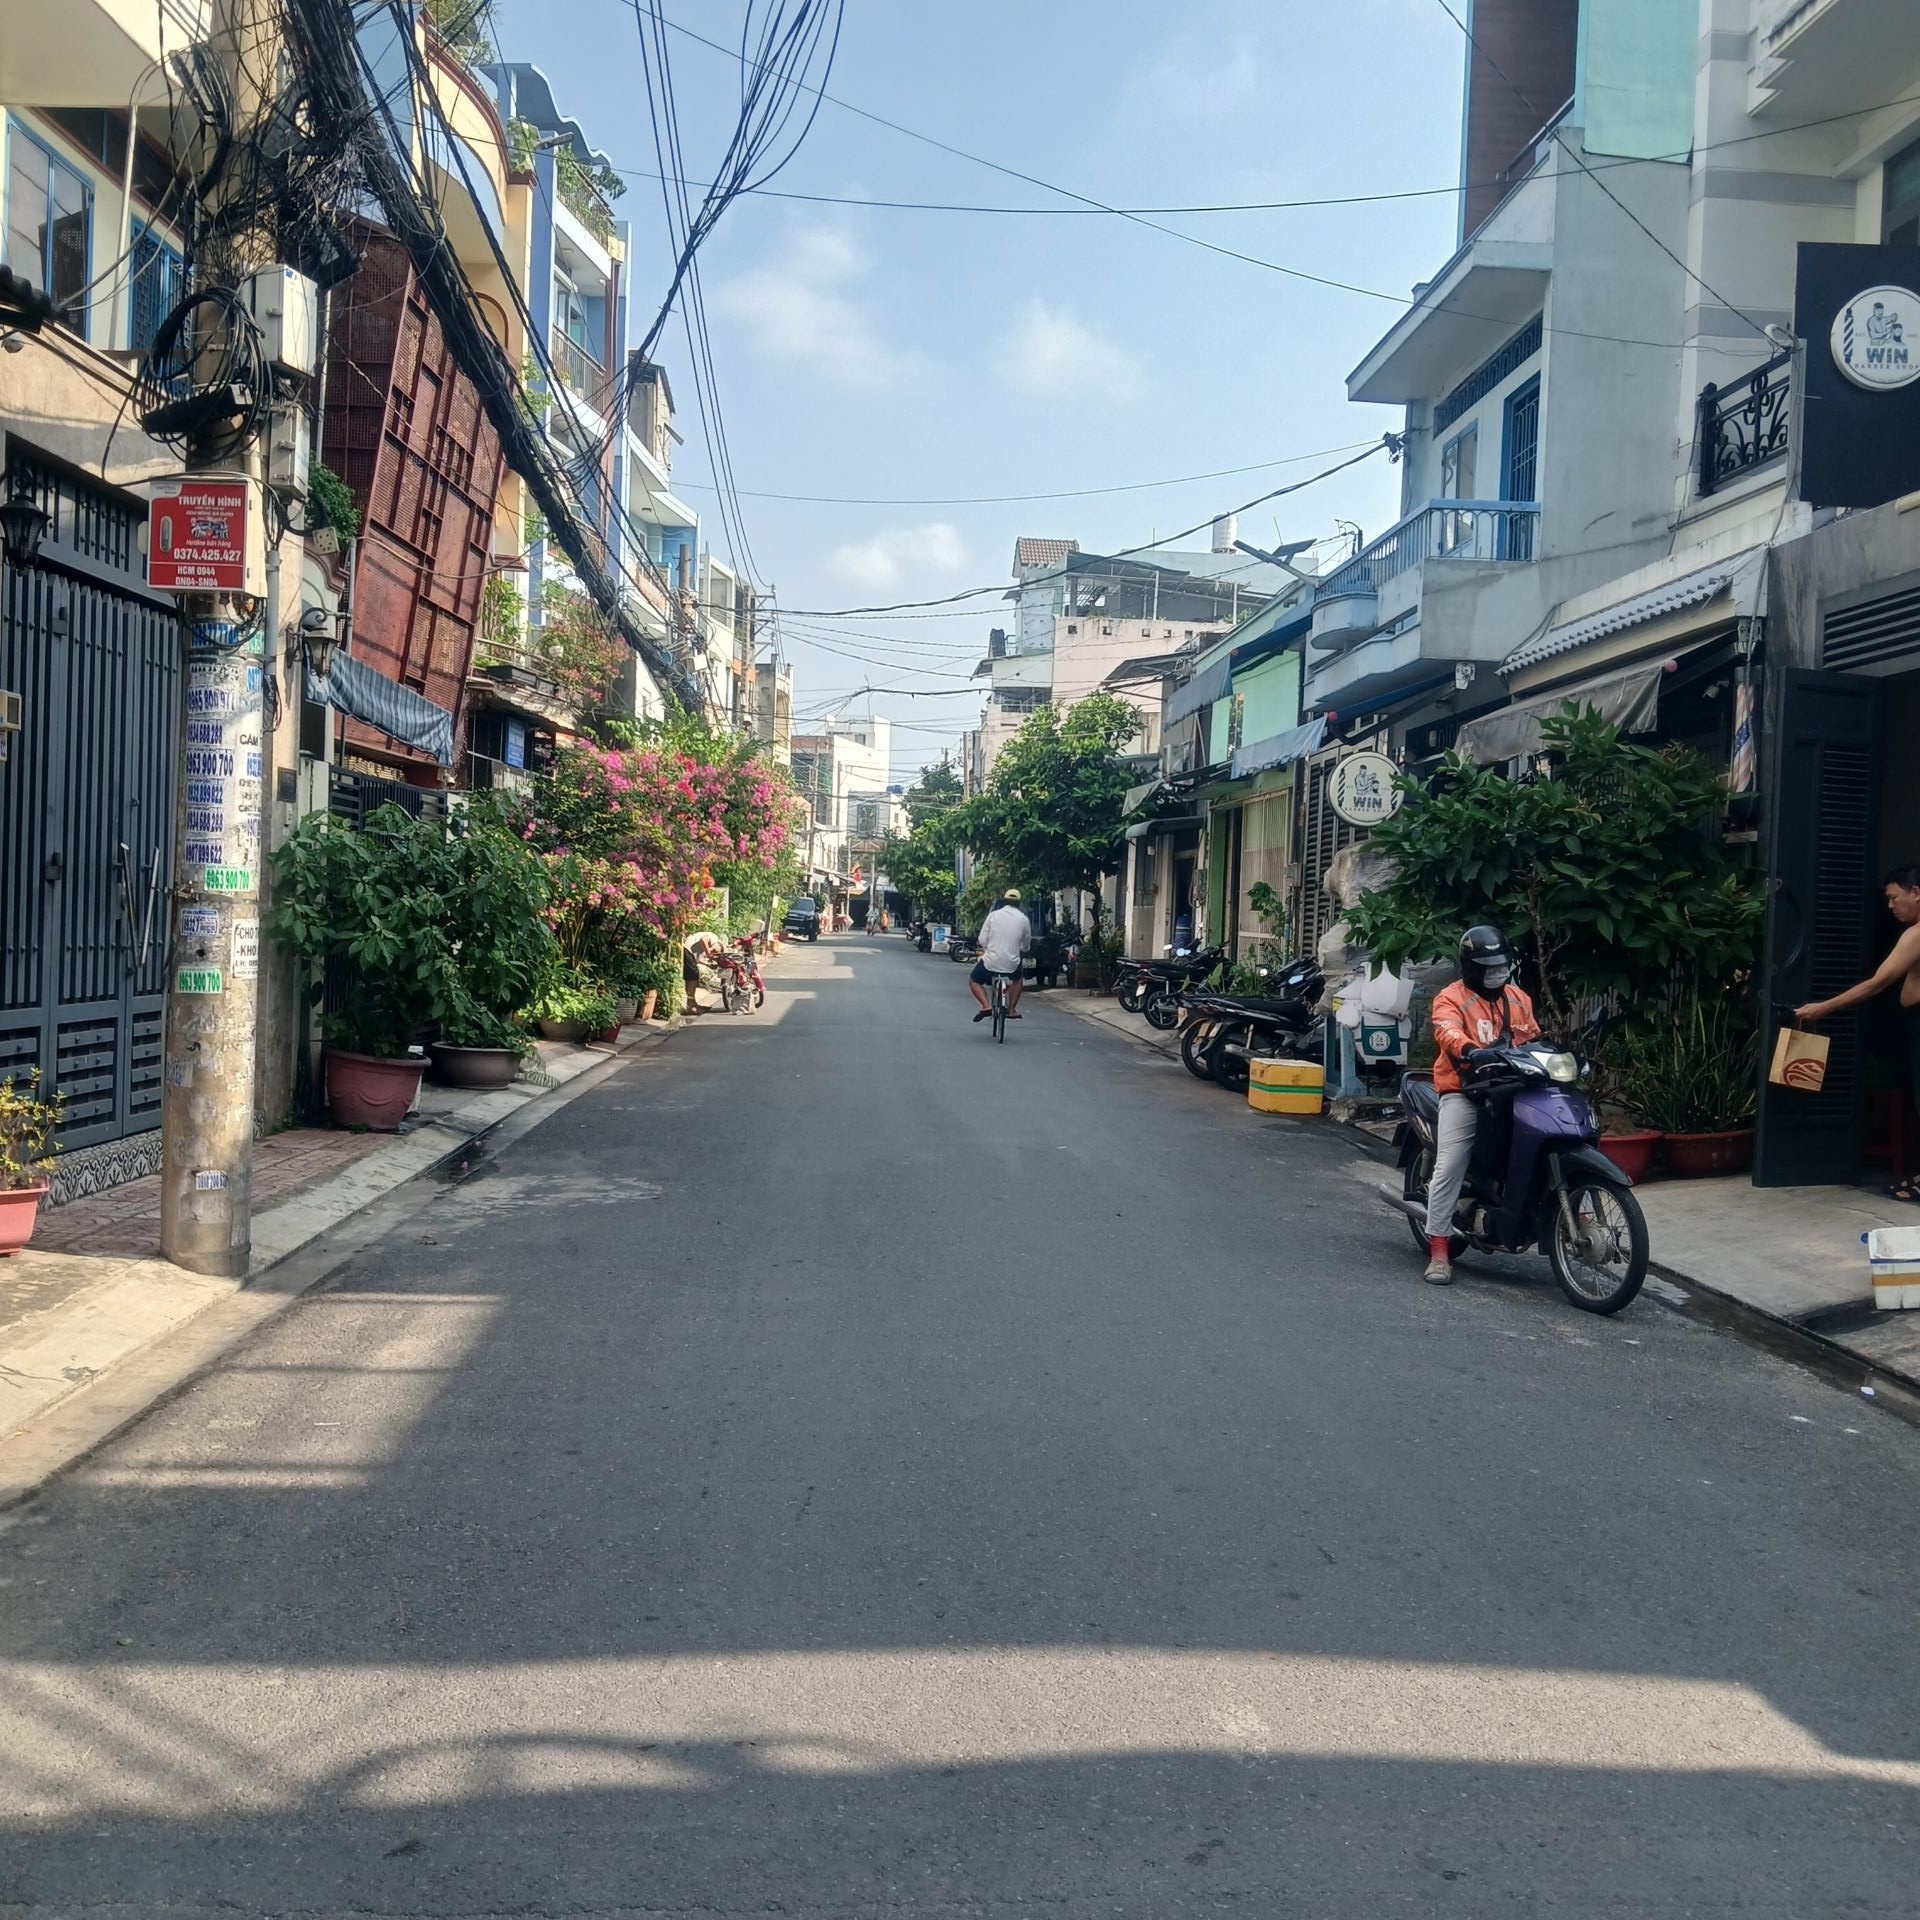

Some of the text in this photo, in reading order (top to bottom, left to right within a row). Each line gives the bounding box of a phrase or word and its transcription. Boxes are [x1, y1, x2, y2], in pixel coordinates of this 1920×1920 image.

[1866, 348, 1908, 364] WIN
[174, 548, 241, 562] 0374.425.427
[177, 566, 215, 576] HCM 0944
[1352, 796, 1382, 808] WIN
